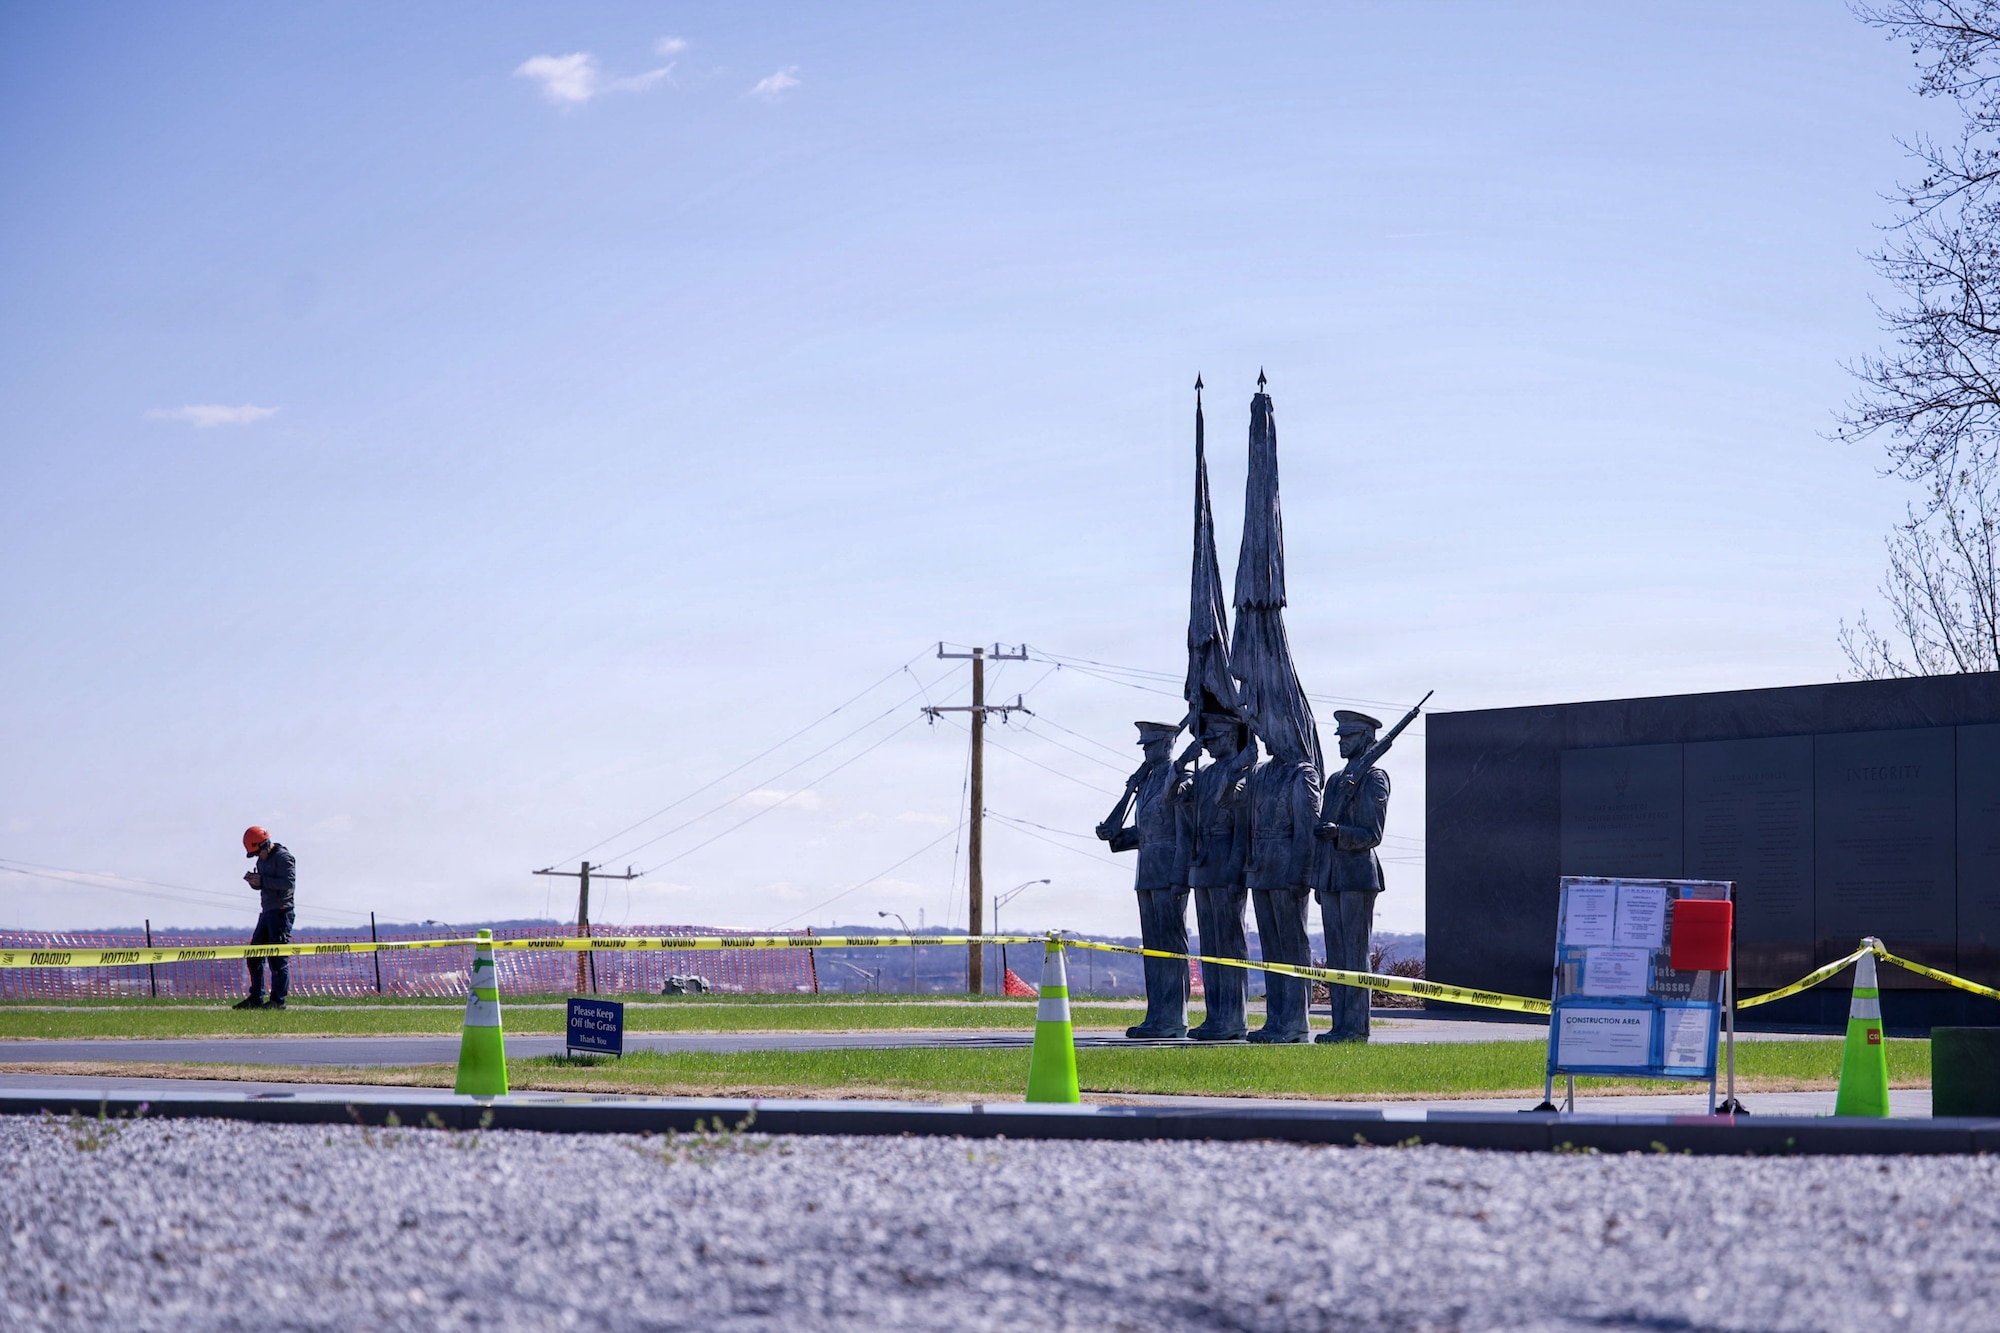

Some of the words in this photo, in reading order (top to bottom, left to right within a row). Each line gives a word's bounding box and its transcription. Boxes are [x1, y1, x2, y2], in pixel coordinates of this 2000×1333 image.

[1847, 765, 1921, 781] INTEGRITY
[1357, 974, 1390, 989] CUIDADO
[1411, 982, 1443, 998] CAUTION
[1471, 991, 1503, 1005] CUIDADO
[573, 1005, 595, 1017] Please
[596, 1007, 614, 1021] Keep
[1520, 999, 1552, 1013] CAUTION
[571, 1017, 583, 1028] Off
[584, 1018, 596, 1029] the
[596, 1020, 617, 1032] Grass
[1566, 1016, 1620, 1025] CONSTRUCTION
[579, 1034, 596, 1044] Thank
[597, 1036, 607, 1045] You
